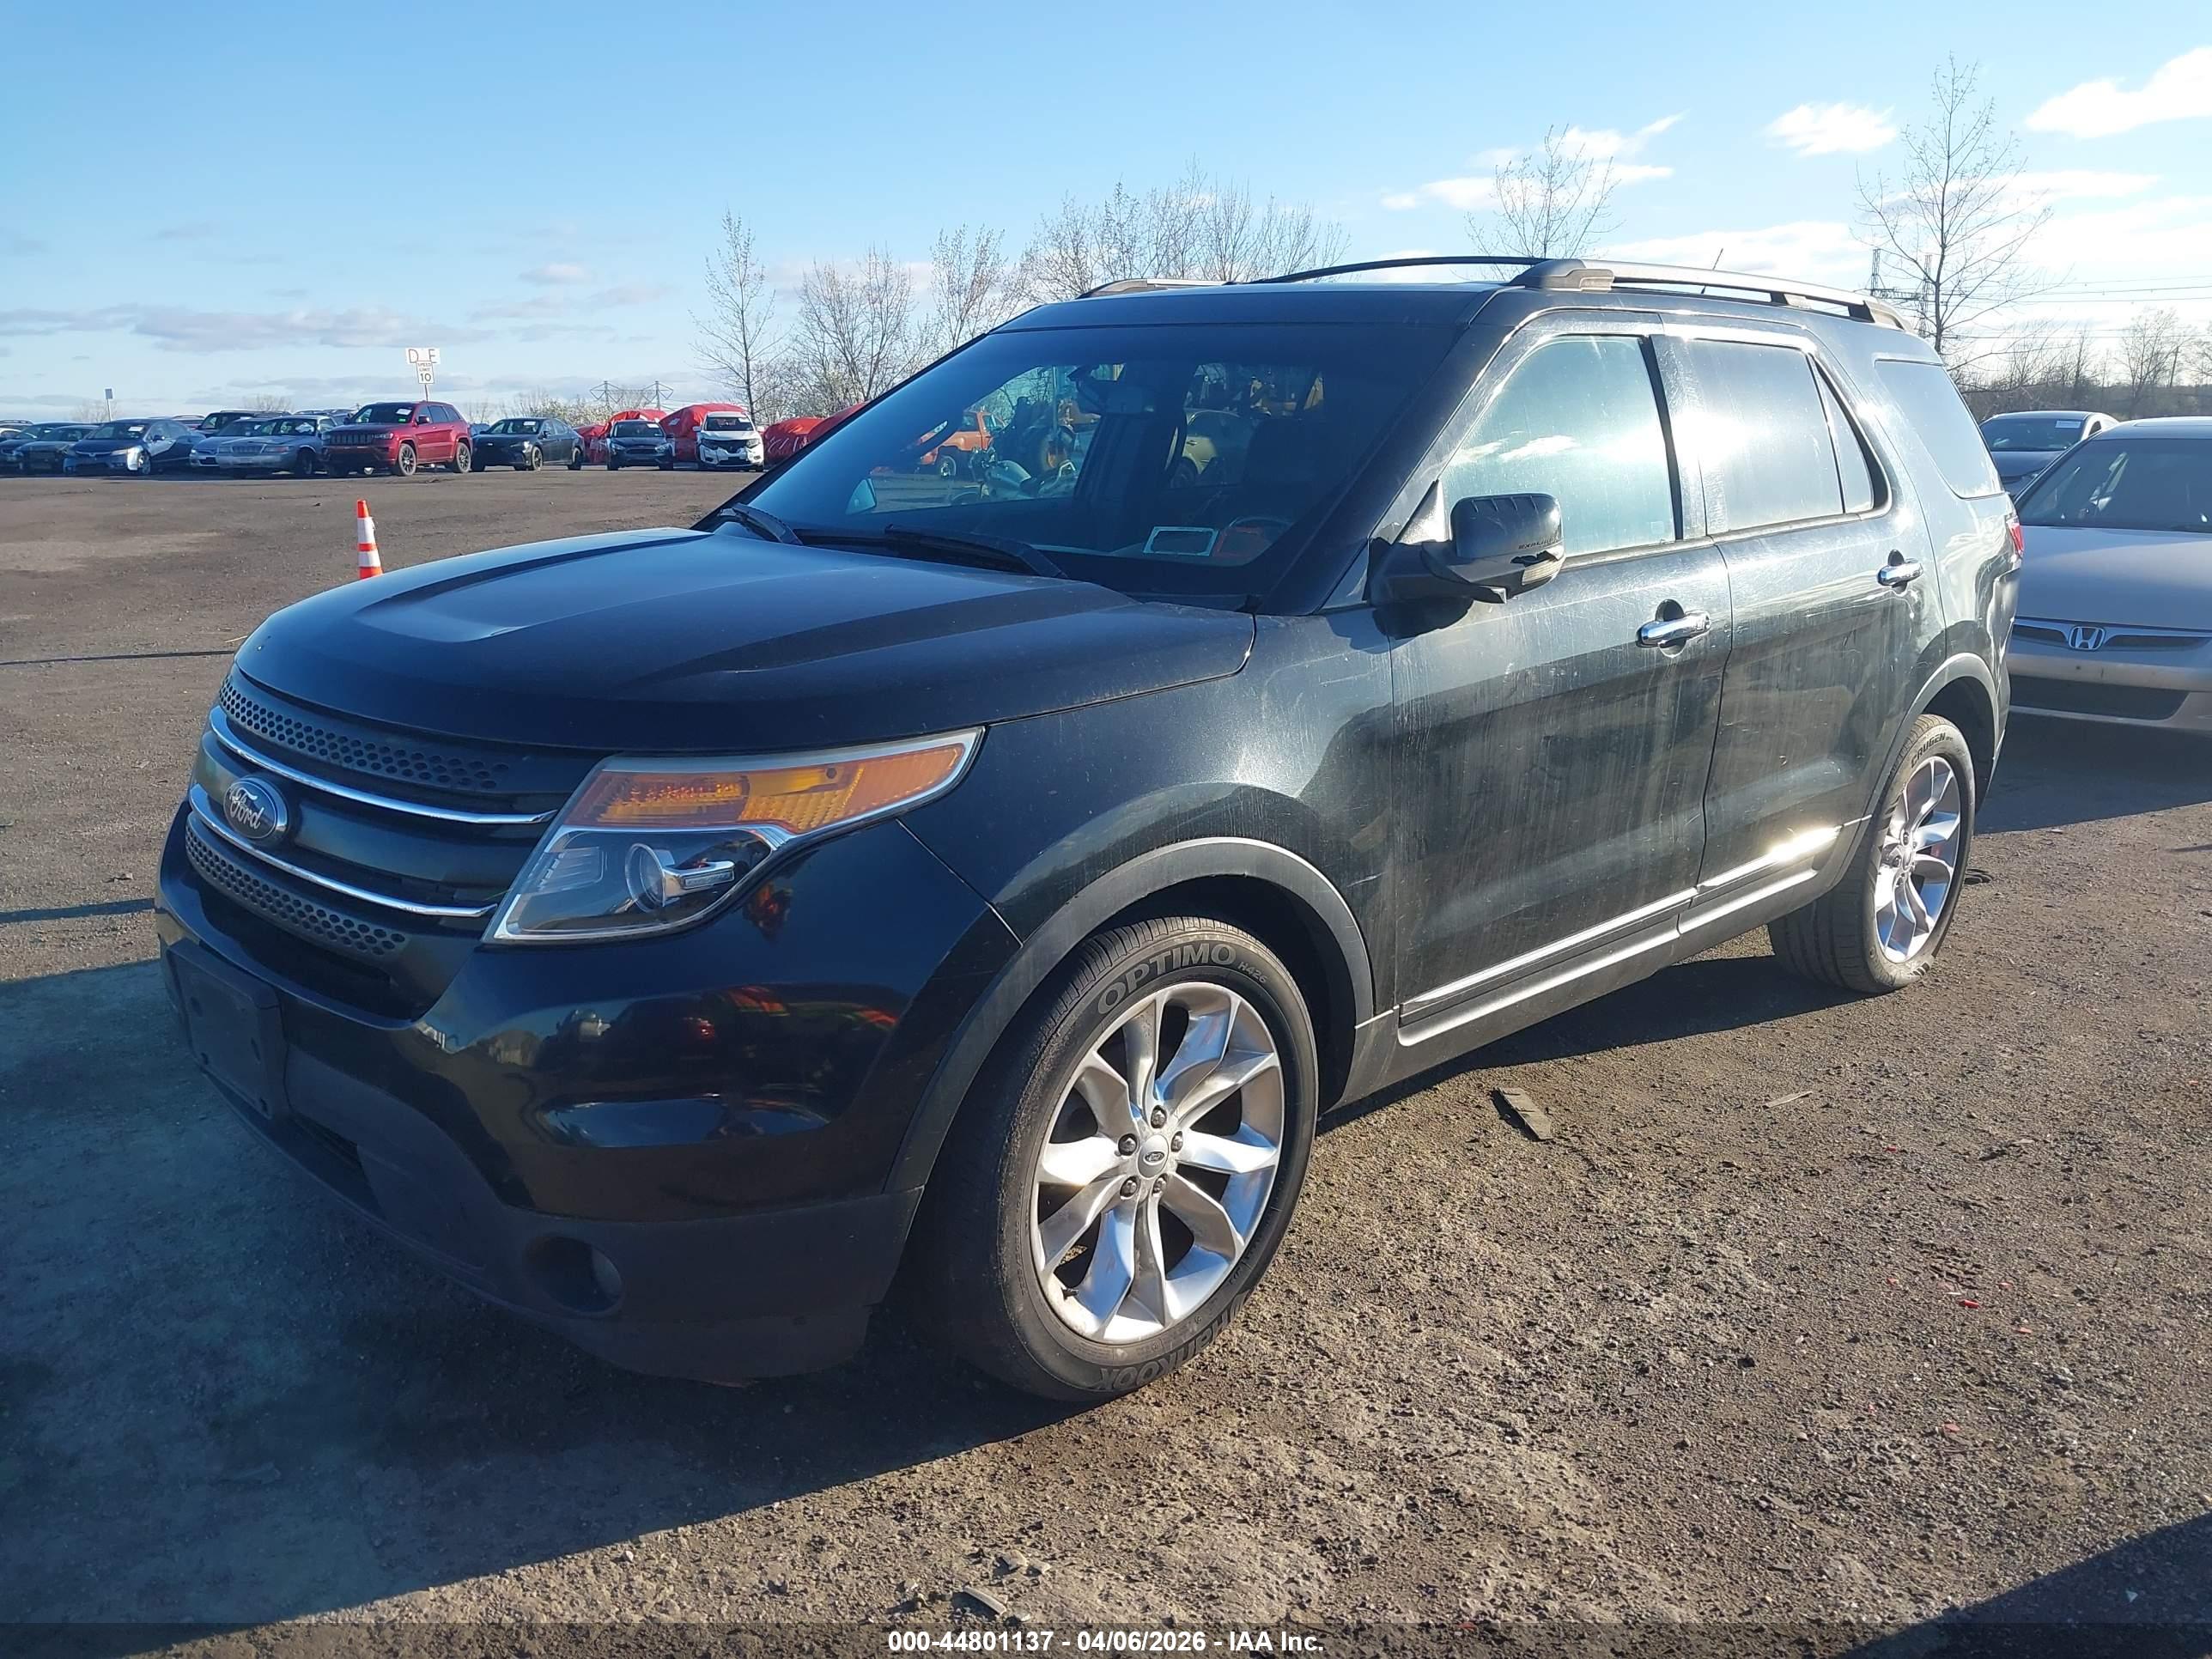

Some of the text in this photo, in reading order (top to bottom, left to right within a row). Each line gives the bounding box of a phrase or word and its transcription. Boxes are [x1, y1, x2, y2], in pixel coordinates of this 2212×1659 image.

[408, 349, 419, 364] D
[420, 373, 432, 382] 10
[1097, 943, 1269, 1015] OPTIMO H426
